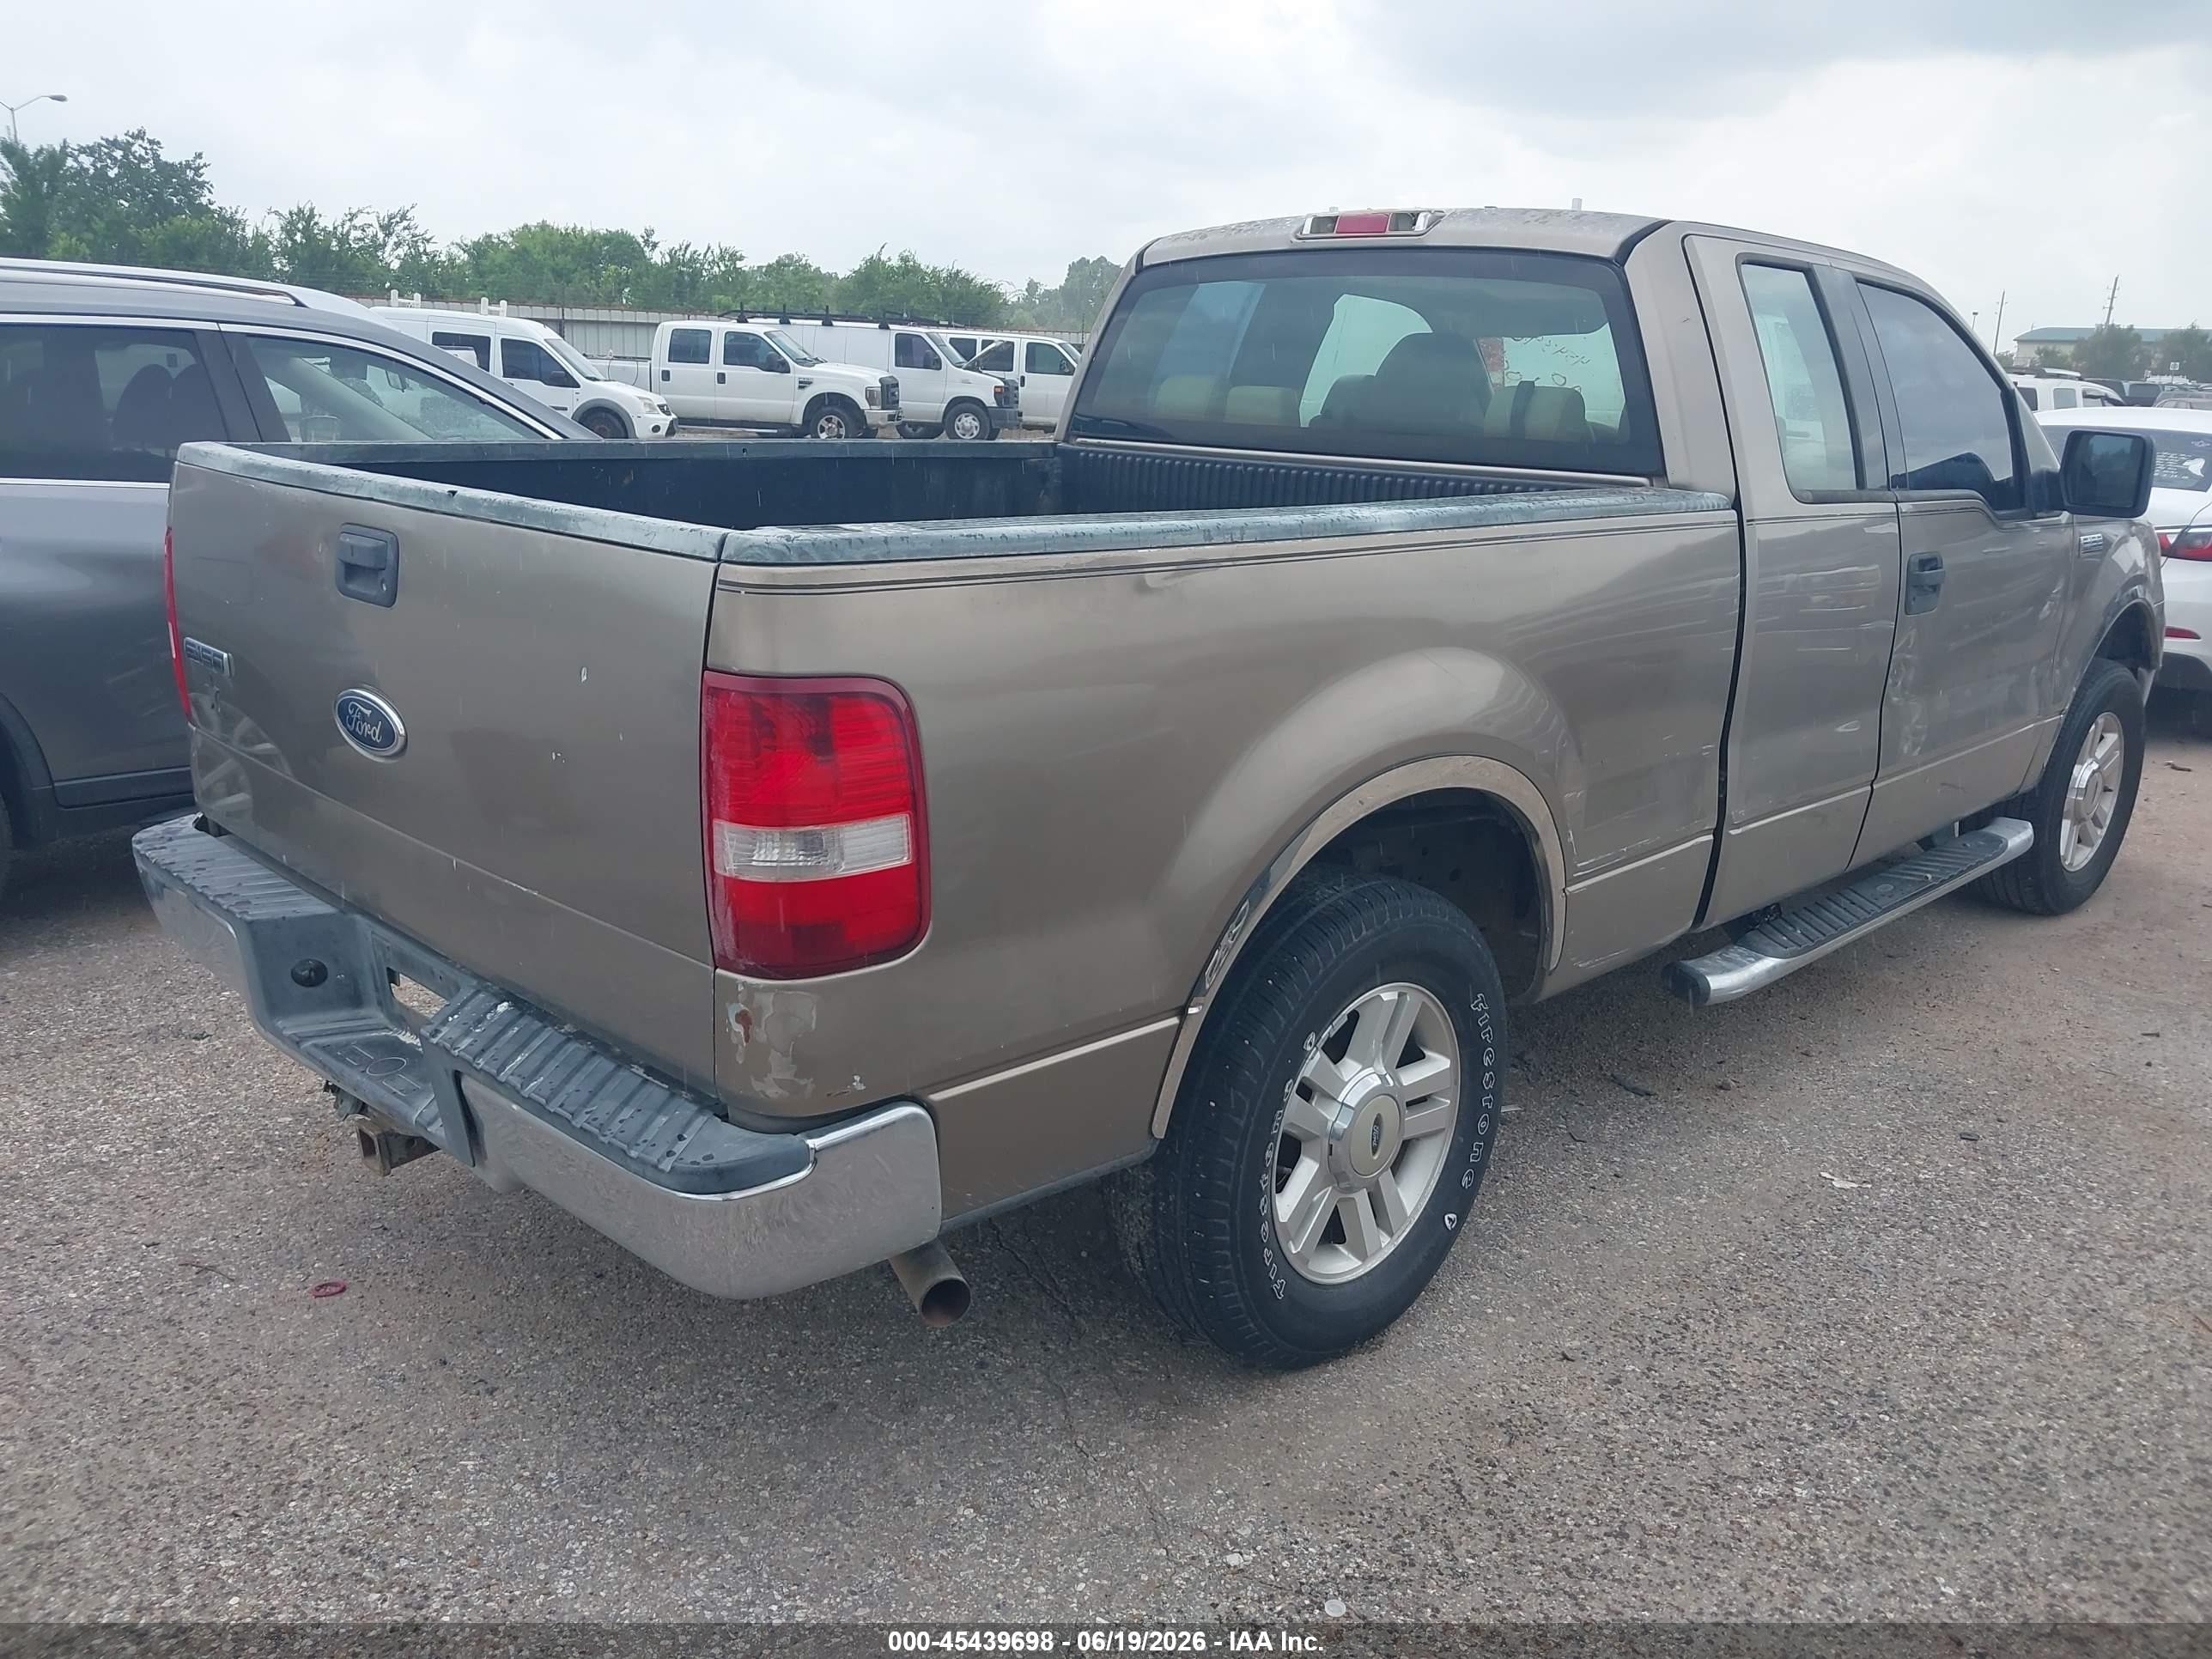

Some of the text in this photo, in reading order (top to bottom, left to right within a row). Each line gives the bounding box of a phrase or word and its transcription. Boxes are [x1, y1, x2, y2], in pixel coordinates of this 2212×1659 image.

[346, 701, 383, 743] Ford
[1259, 1078, 1293, 1300] Firestone
[1462, 993, 1496, 1189] Firestone
